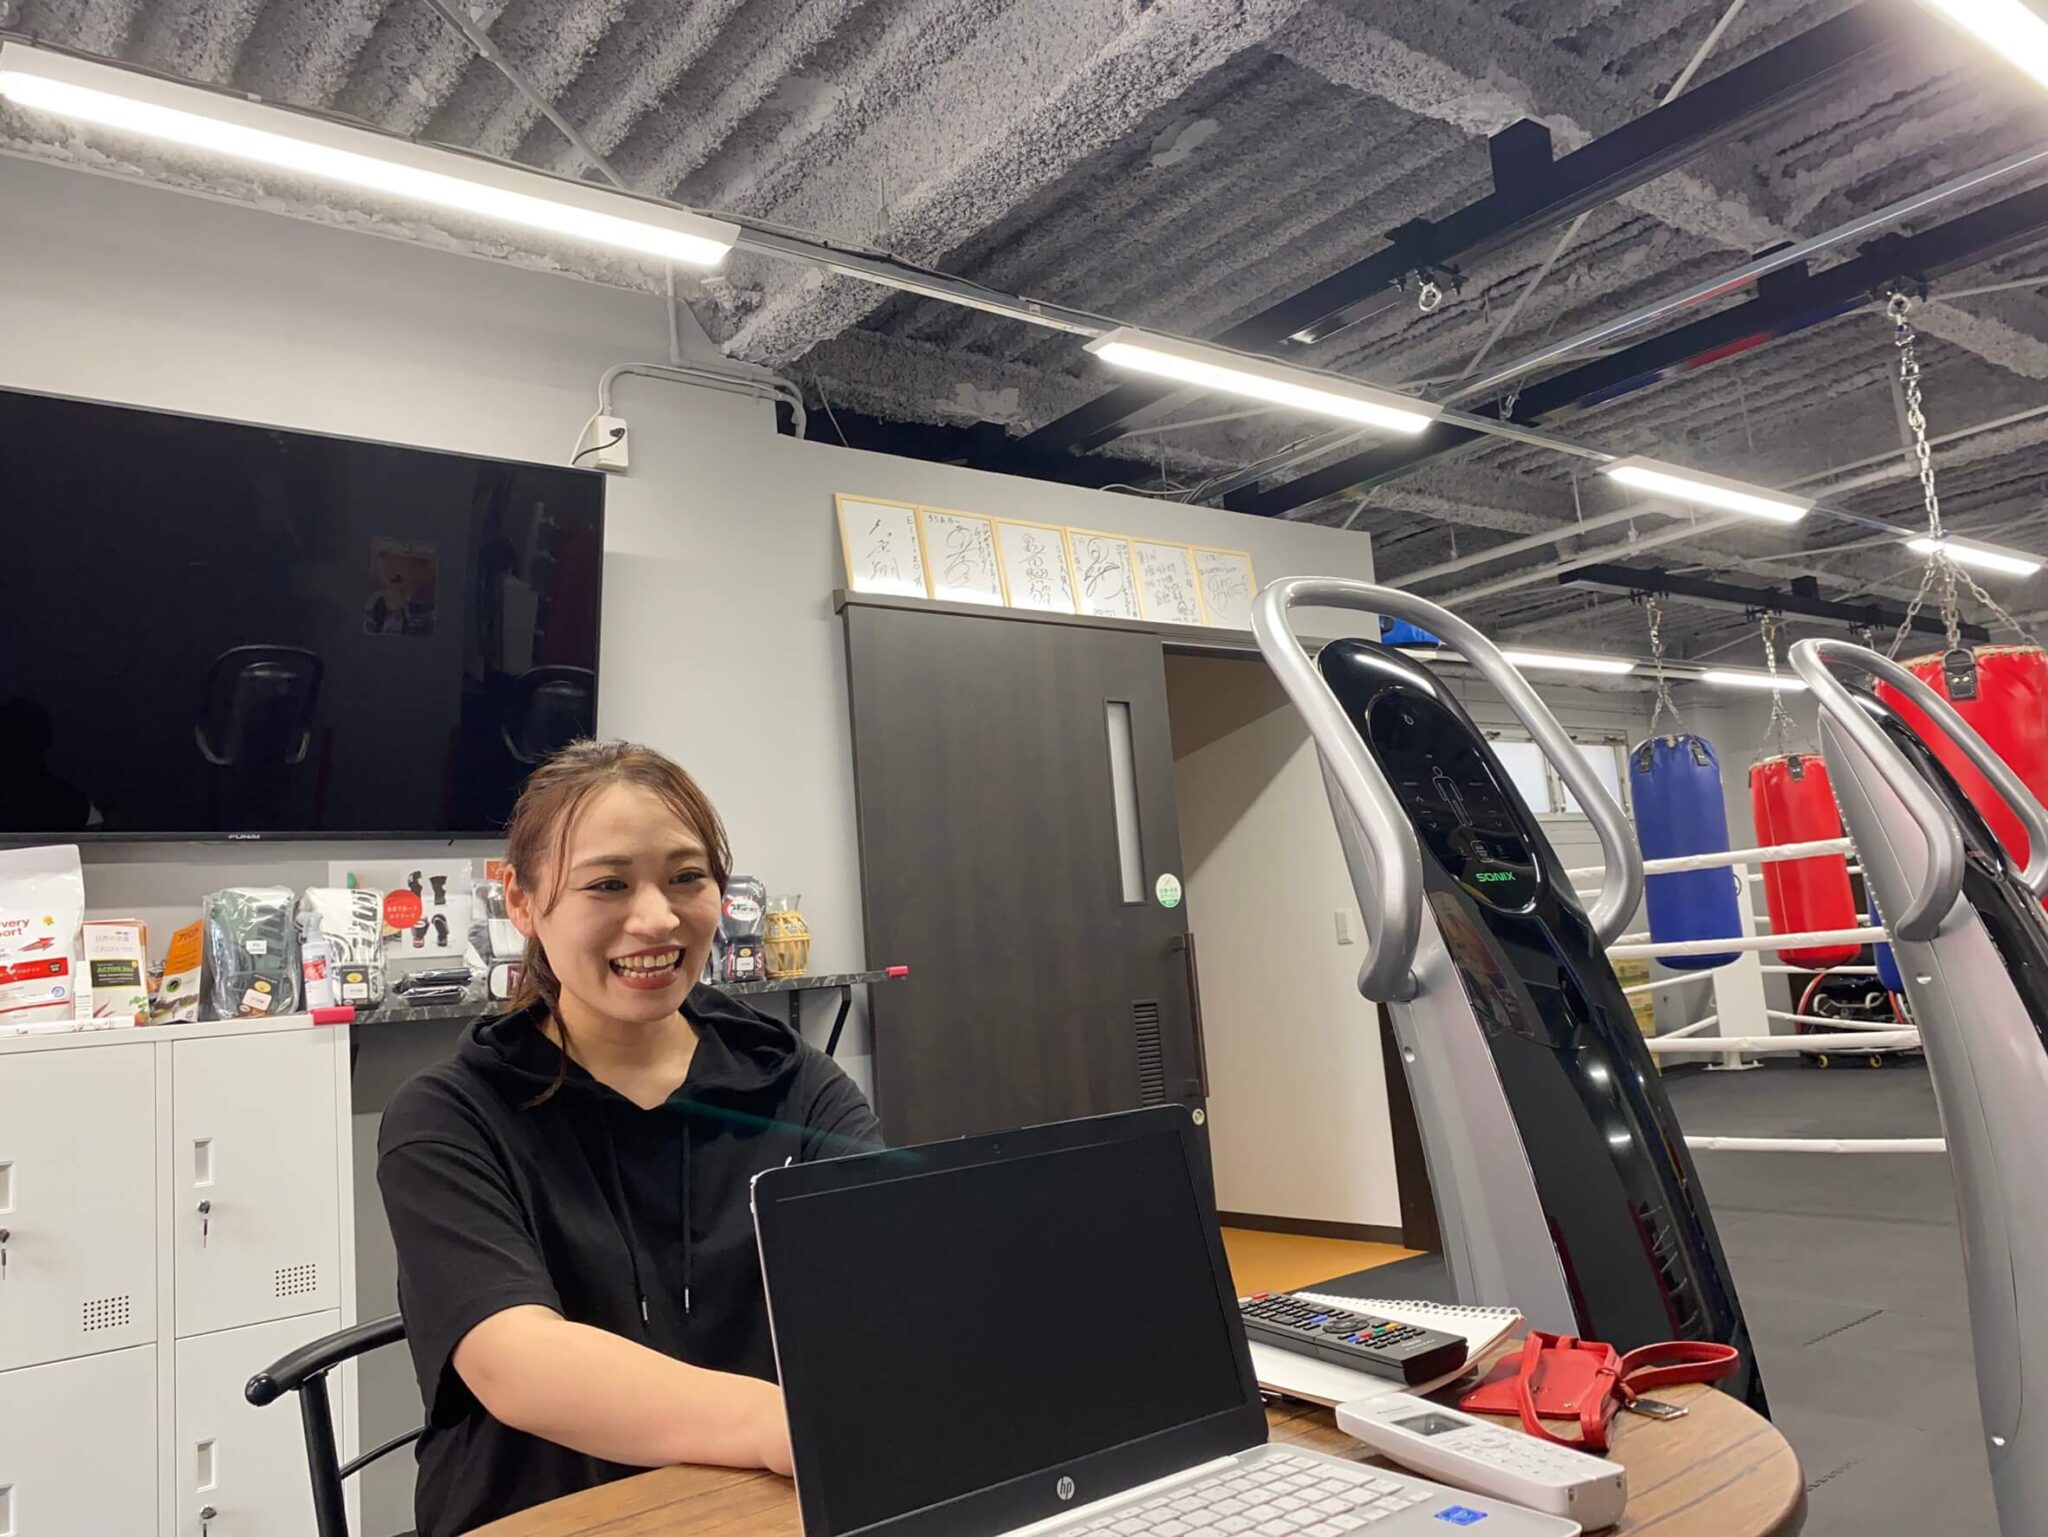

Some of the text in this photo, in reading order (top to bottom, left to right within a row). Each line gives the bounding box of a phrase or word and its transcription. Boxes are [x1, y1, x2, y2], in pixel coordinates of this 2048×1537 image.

[1475, 871, 1517, 882] SONIX
[0, 927, 23, 937] ort
[1060, 1477, 1072, 1500] hp
